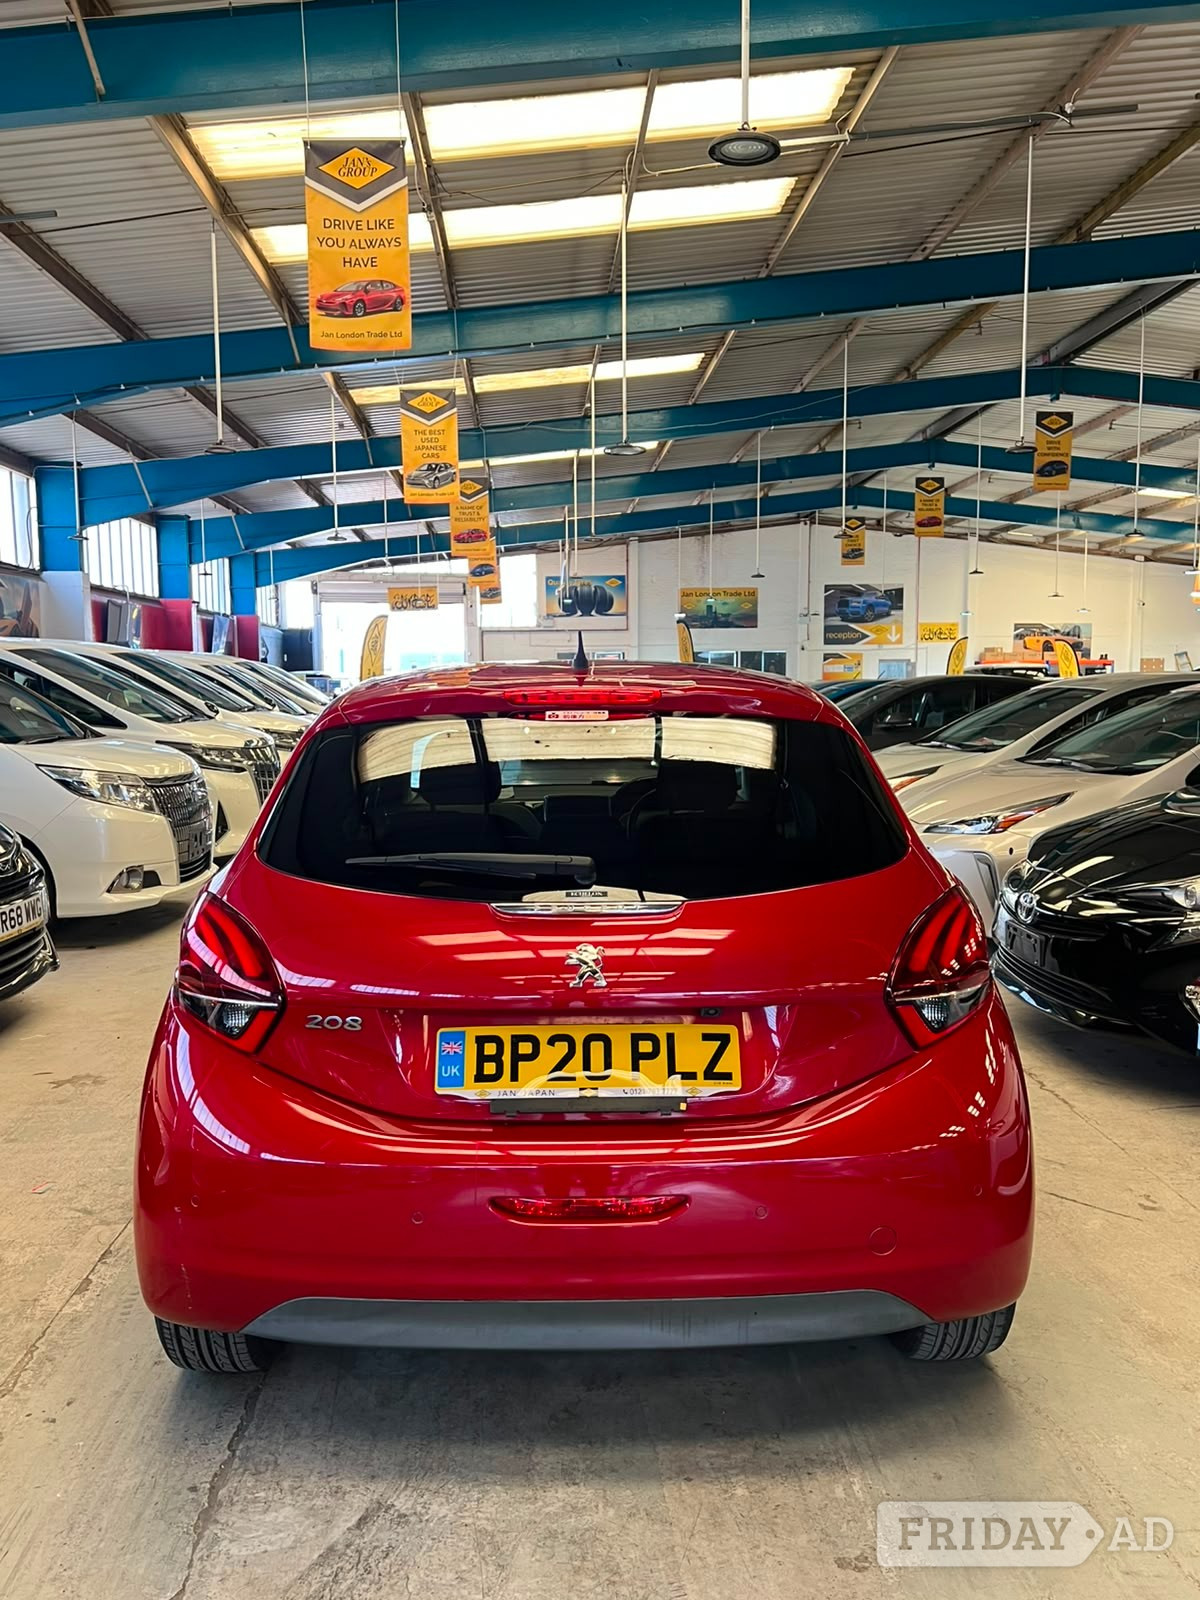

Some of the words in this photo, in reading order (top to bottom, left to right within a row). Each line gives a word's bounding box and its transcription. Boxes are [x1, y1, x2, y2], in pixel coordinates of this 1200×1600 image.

[338, 167, 378, 178] GROUP
[323, 218, 363, 231] DRIVE
[366, 218, 395, 231] LIKE
[316, 237, 345, 249] YOU
[349, 237, 402, 250] ALWAYS
[342, 256, 378, 268] HAVE
[320, 331, 334, 339] Jan
[336, 331, 365, 339] London
[366, 330, 388, 339] Trade
[389, 330, 403, 338] Ltd
[825, 631, 862, 640] reception
[24, 897, 42, 923] WWG
[305, 1014, 362, 1031] 208
[473, 1032, 612, 1083] BP20
[630, 1032, 733, 1082] PLZ
[441, 1064, 460, 1077] UK
[497, 1089, 517, 1097] JAN
[523, 1089, 556, 1097] JAPAN
